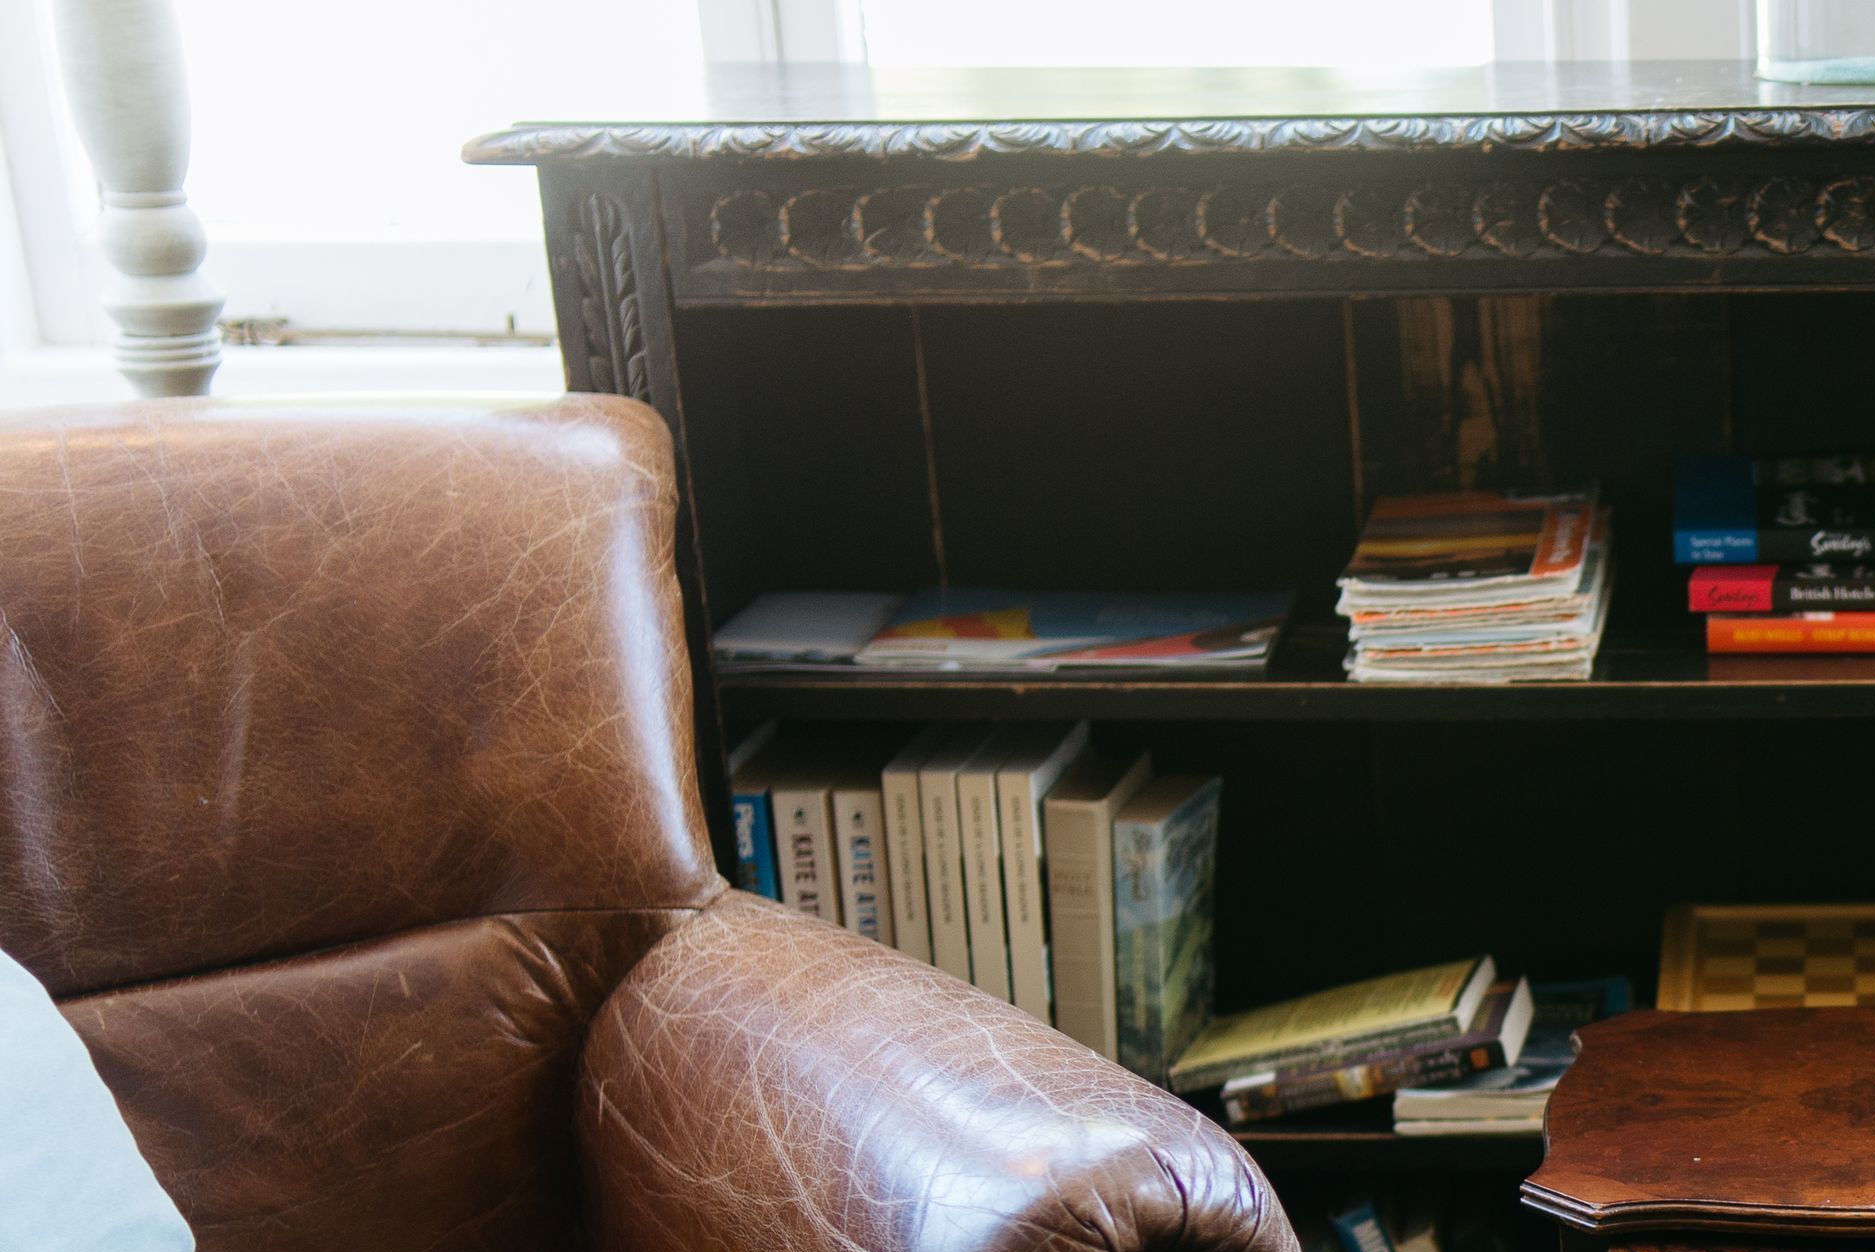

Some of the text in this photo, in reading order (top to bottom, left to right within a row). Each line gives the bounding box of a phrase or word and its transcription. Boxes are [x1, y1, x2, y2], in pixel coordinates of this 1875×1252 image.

[1789, 586, 1831, 601] British
[734, 803, 754, 859] Piers
[792, 833, 817, 884] KATE
[851, 836, 874, 886] KATE
